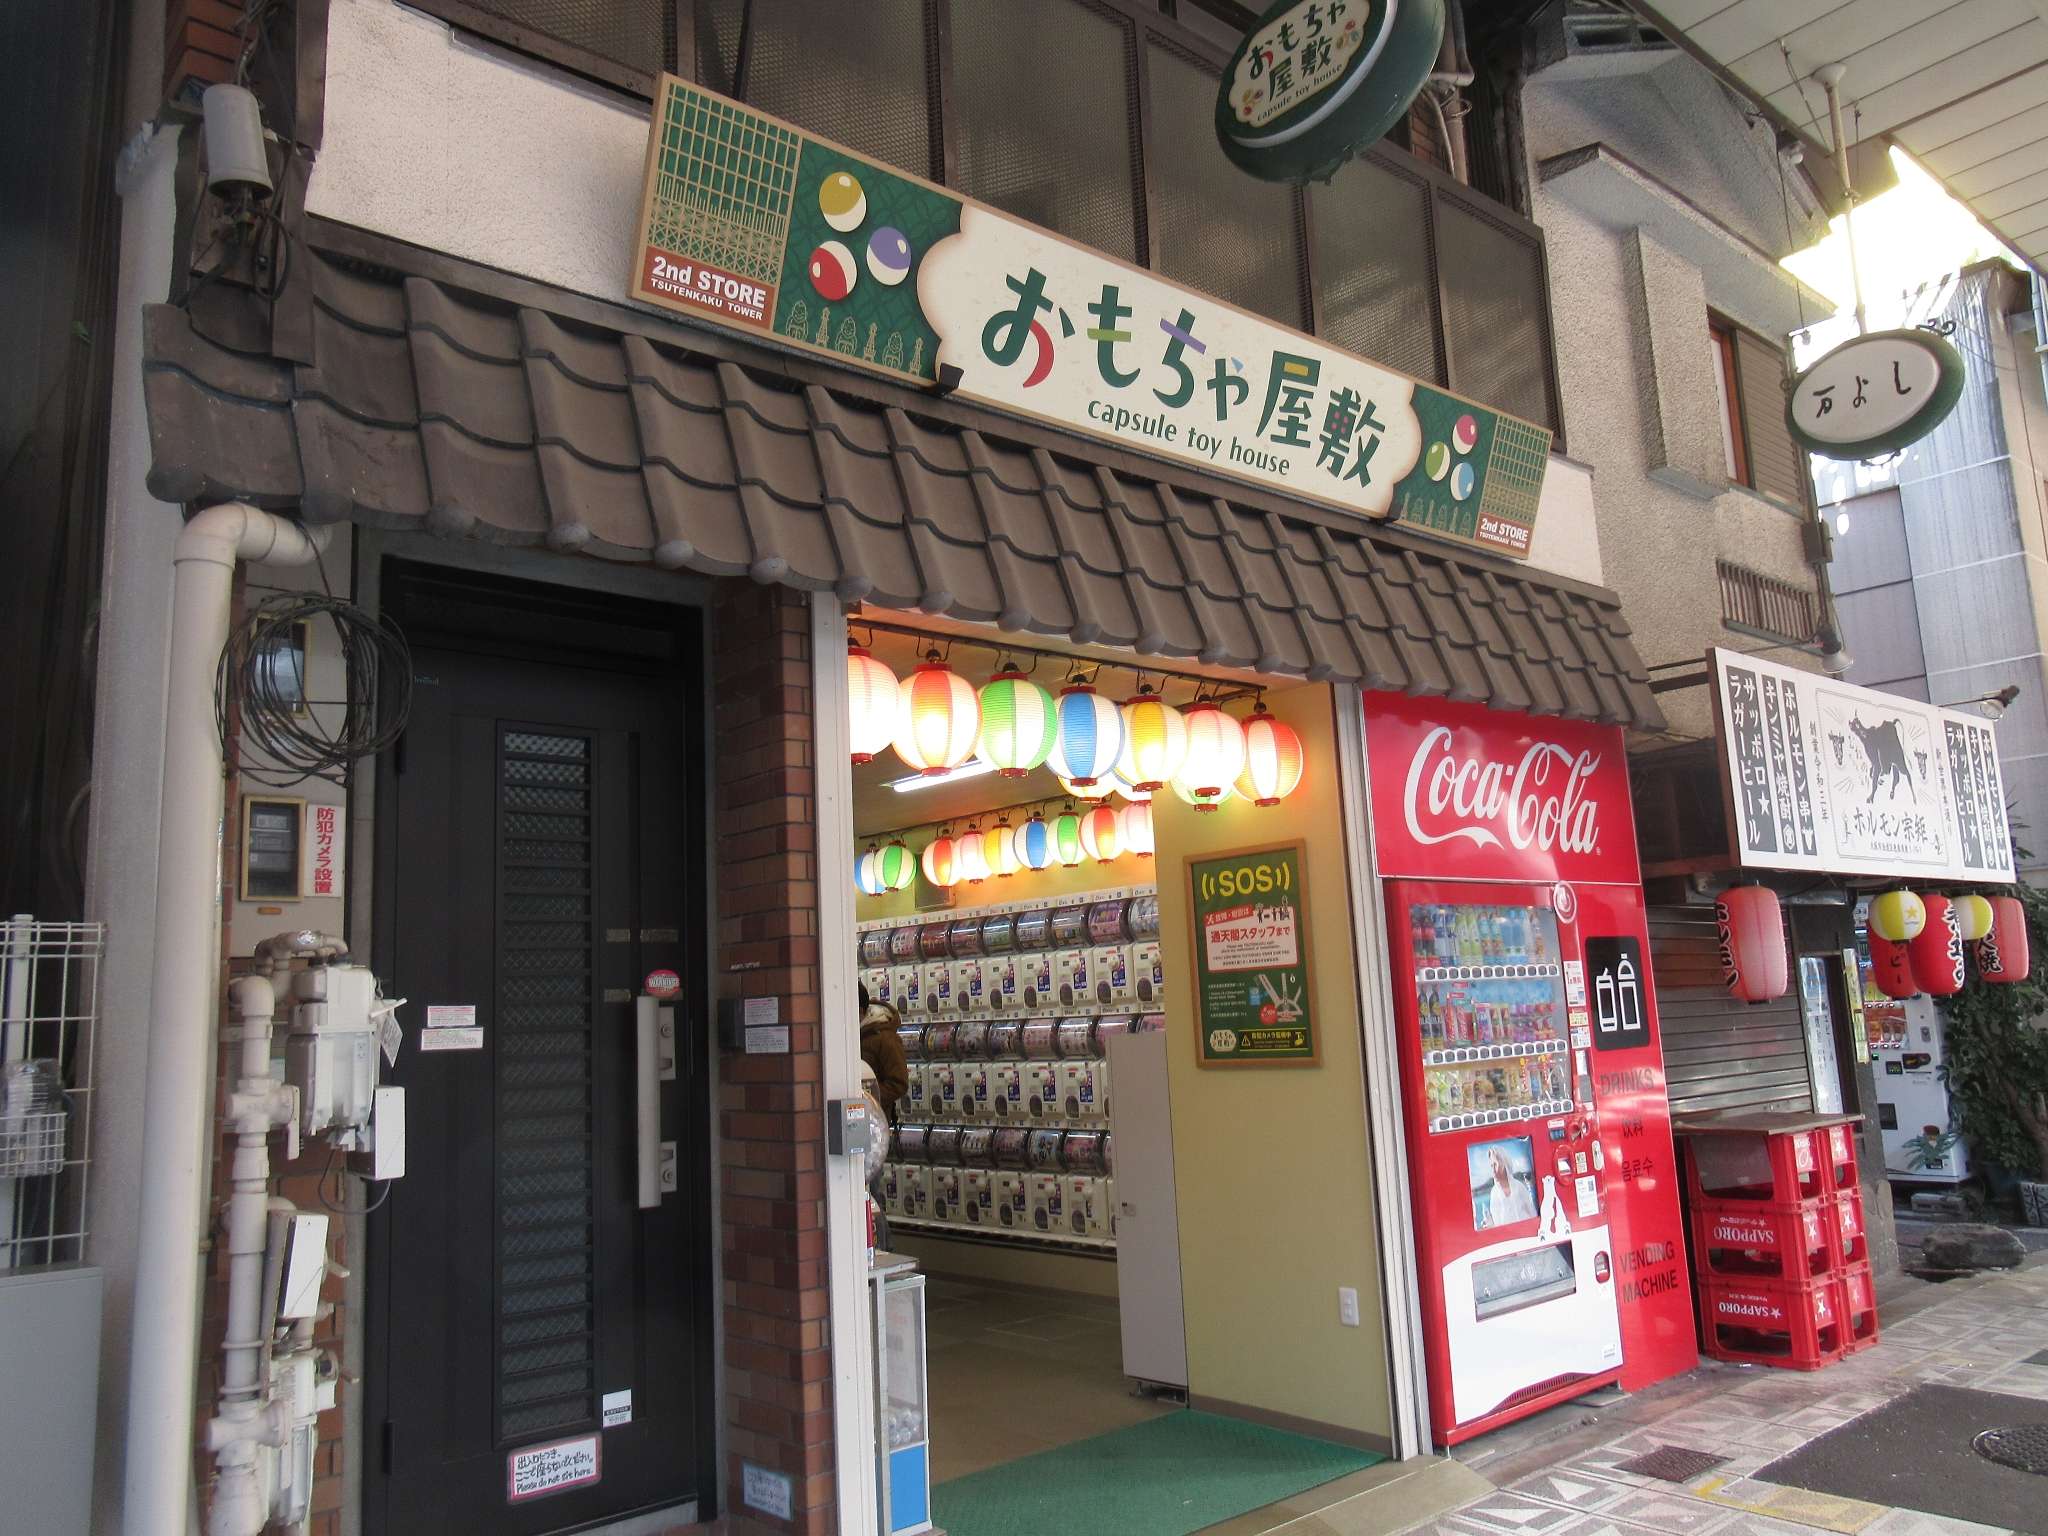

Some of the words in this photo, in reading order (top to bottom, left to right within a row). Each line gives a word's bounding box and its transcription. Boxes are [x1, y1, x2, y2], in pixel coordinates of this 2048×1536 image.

[1257, 94, 1292, 121] capsule
[1295, 83, 1310, 98] toy
[1313, 63, 1343, 86] house
[651, 256, 692, 283] 2nd
[697, 270, 767, 310] STORE
[651, 279, 723, 308] TSUTENKAKU
[727, 303, 763, 321] TOWER
[980, 266, 1386, 488] おもちゃ屋敷
[1088, 400, 1177, 442] capsule
[1187, 425, 1222, 460] toy
[1229, 437, 1291, 476] house
[1480, 518, 1497, 533] 2nd
[1499, 523, 1529, 542] STORE
[1729, 674, 1761, 846] ラガービール
[1404, 727, 1602, 854] Coca-Cola
[314, 807, 336, 895] 防犯カメラ設置
[1218, 864, 1274, 897] SOS
[1211, 925, 1291, 944] 通天閣スタッフまで
[1600, 1068, 1655, 1097] DRINKS
[1621, 1158, 1654, 1183] 음료수
[1713, 1226, 1774, 1243] SAPPORO
[1620, 1241, 1675, 1275] VENDING
[1622, 1269, 1679, 1304] MACHINE
[1719, 1302, 1769, 1317] SAPPORO
